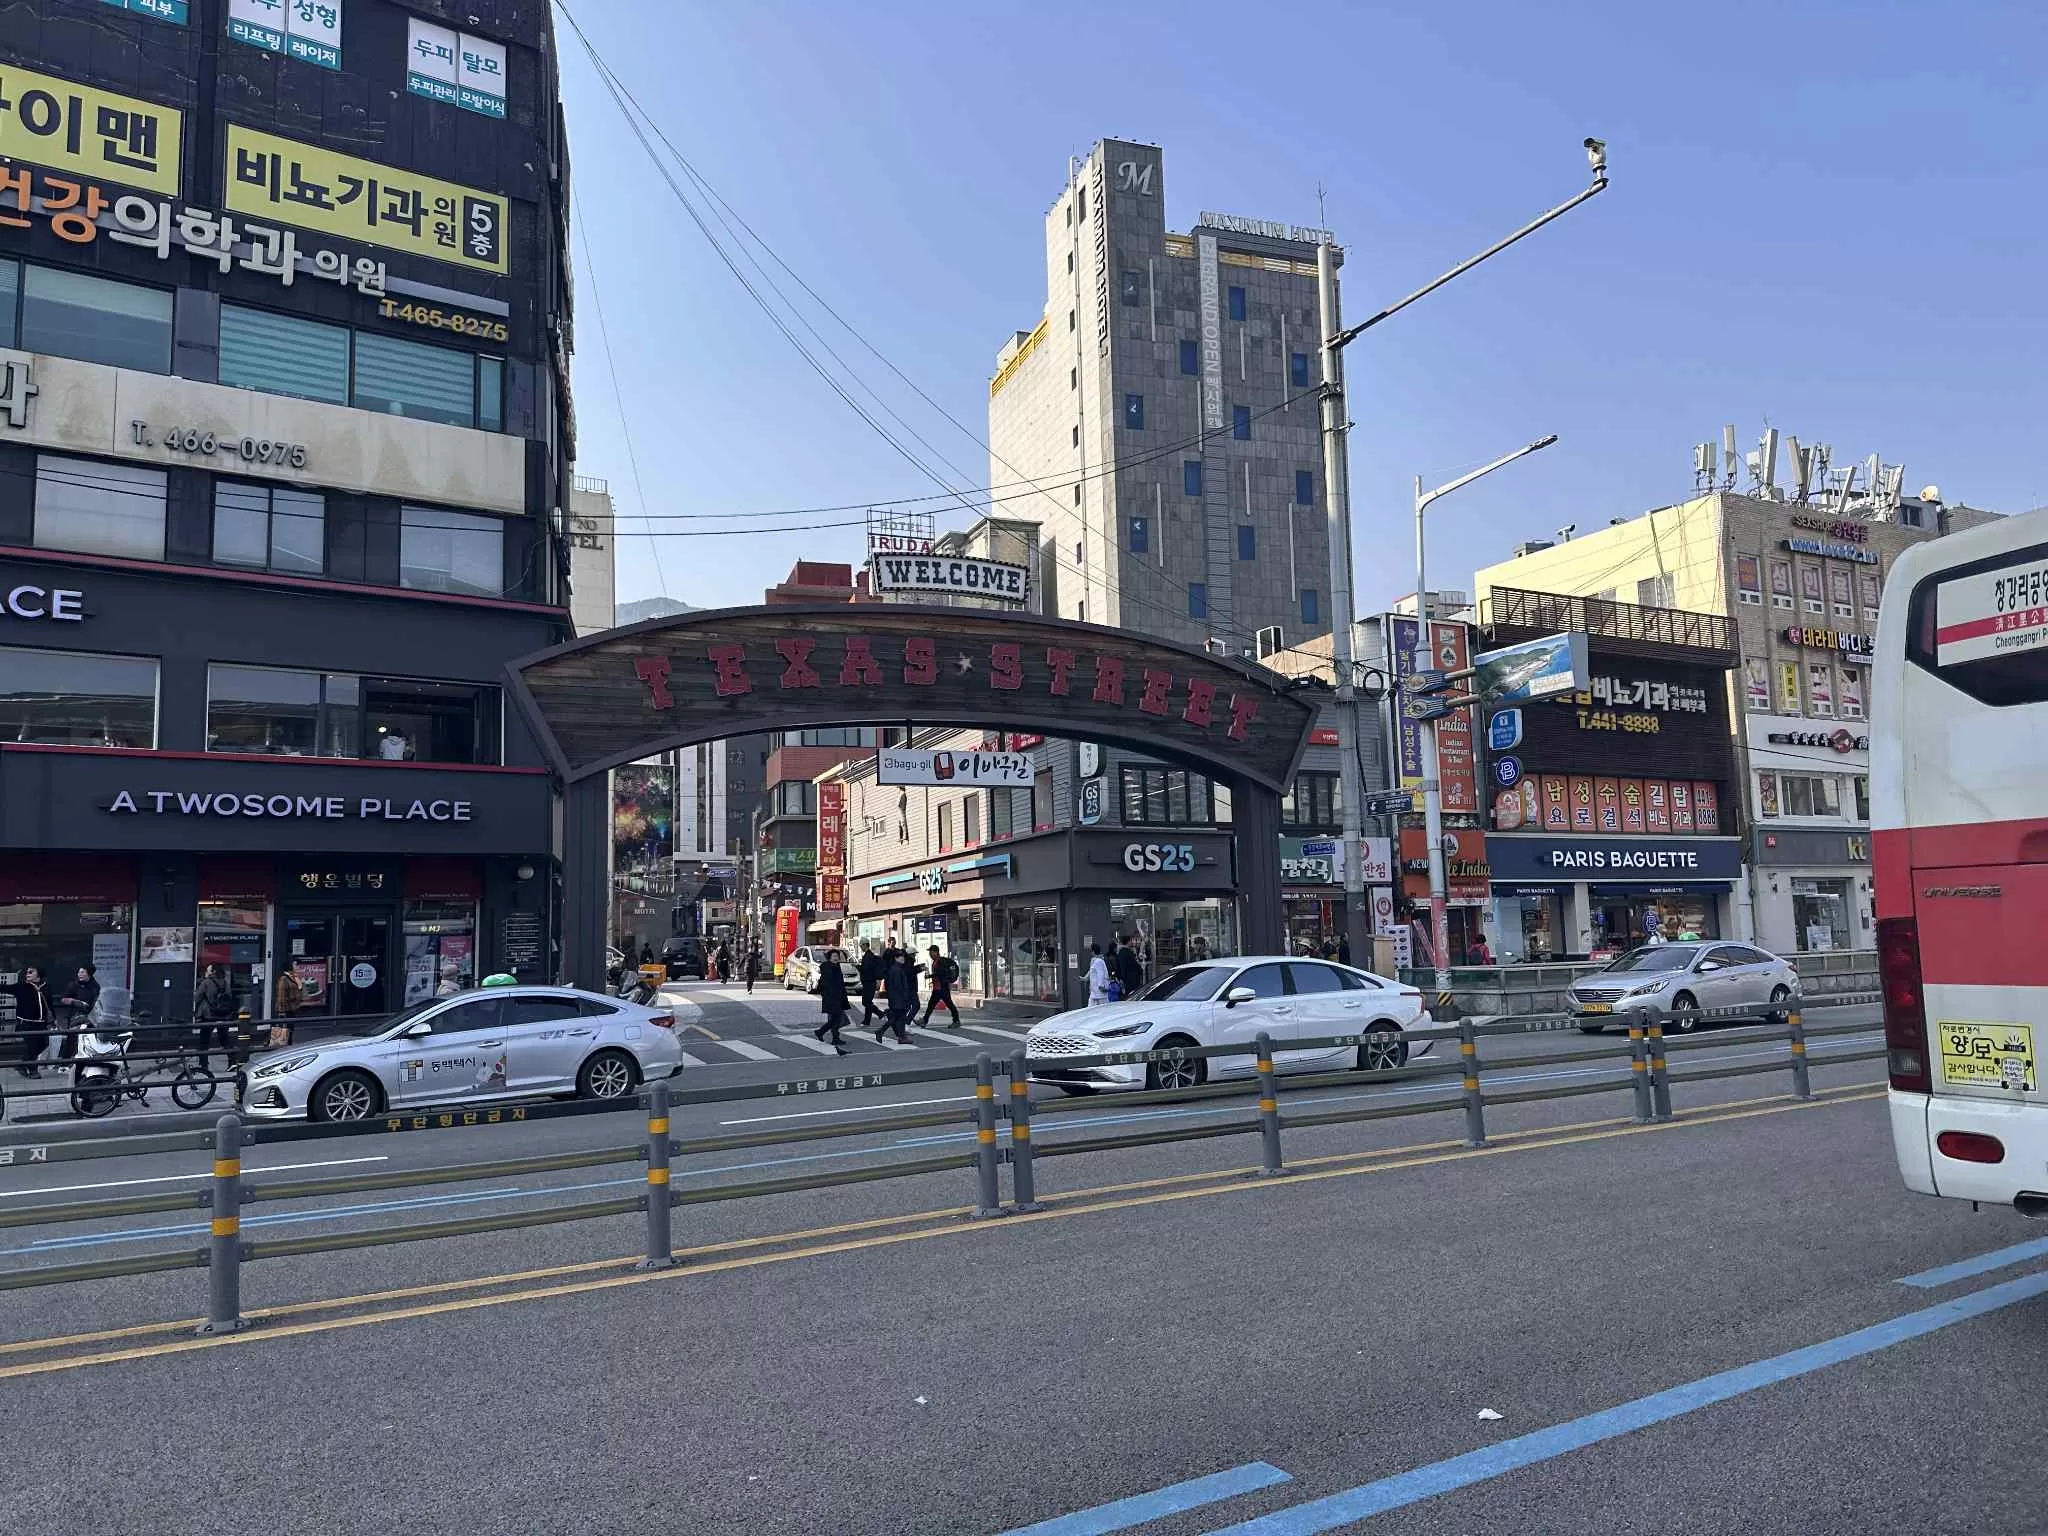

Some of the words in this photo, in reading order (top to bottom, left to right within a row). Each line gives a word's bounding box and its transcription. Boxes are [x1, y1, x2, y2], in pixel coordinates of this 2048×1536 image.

[233, 24, 281, 50] 리프팅
[292, 41, 337, 65] 레이저
[413, 39, 454, 66] 두피
[462, 51, 502, 76] 탈모
[409, 77, 456, 101] 두피관리
[461, 91, 506, 116] 모발이식
[1115, 160, 1154, 197] M
[235, 147, 430, 238] 비뇨기과
[433, 196, 457, 249] 의원
[470, 203, 494, 258] 5층
[1200, 210, 1286, 239] MAXIMUM
[1290, 225, 1337, 245] HOTEL
[313, 249, 387, 298] 의원
[1204, 325, 1222, 372] OPEN
[132, 420, 154, 447] T.
[880, 520, 923, 533] HOTEL
[870, 535, 932, 554] IRUDA
[884, 559, 1021, 594] WELCOME
[0, 584, 83, 621] CE
[1995, 628, 2041, 649] Cheonggangri
[632, 635, 942, 711] TEXAS
[990, 643, 1262, 742] STREET
[1593, 676, 1670, 711] 비뇨기과
[1439, 715, 1469, 733] India
[958, 753, 1029, 780] 이바구길
[110, 790, 138, 813] A
[147, 791, 345, 818] TWOSOME
[359, 798, 473, 821] PLACE
[1085, 786, 1099, 800] GS
[1546, 779, 1642, 807] 남성수술
[1086, 801, 1099, 814] 25
[1548, 807, 1642, 829] 요로결석
[821, 795, 840, 855] 노래방
[1124, 843, 1196, 872] GS25
[1552, 850, 1605, 868] PARIS
[1610, 851, 1699, 868] BAGUETTE
[1847, 836, 1867, 860] kt
[300, 872, 384, 890] 행운빌딩
[918, 866, 946, 895] GS25
[1281, 858, 1329, 880] 밥천국
[1460, 858, 1492, 877] India
[1950, 1034, 1993, 1061] 양보
[431, 1057, 477, 1073] 동백택시
